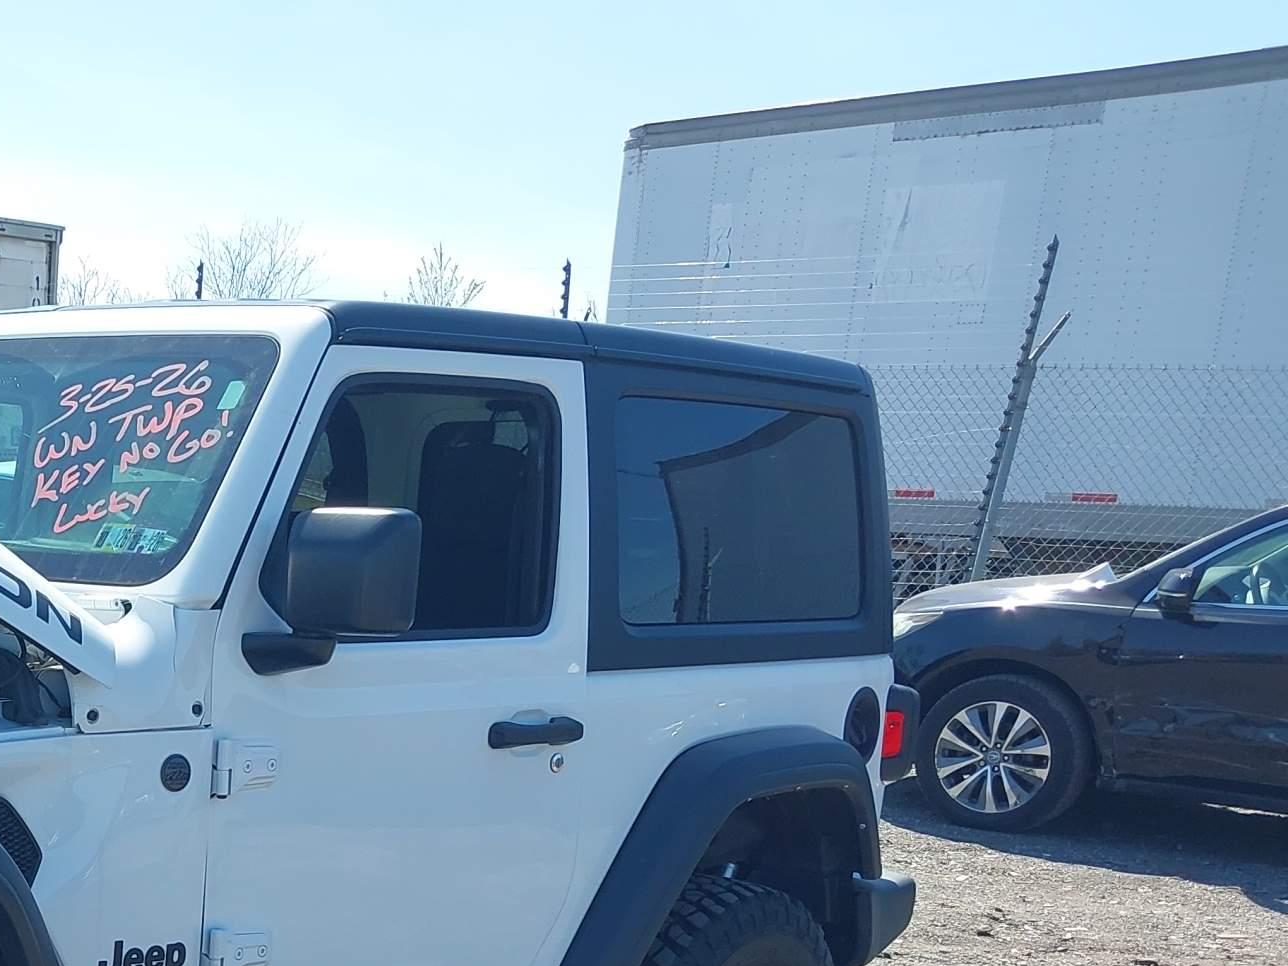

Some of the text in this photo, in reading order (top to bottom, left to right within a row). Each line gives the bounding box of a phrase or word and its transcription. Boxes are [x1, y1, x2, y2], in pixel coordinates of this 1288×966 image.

[37, 359, 213, 434] 3-25-26
[107, 397, 205, 442] TWP
[30, 457, 106, 508] KEY
[119, 441, 161, 474] NO
